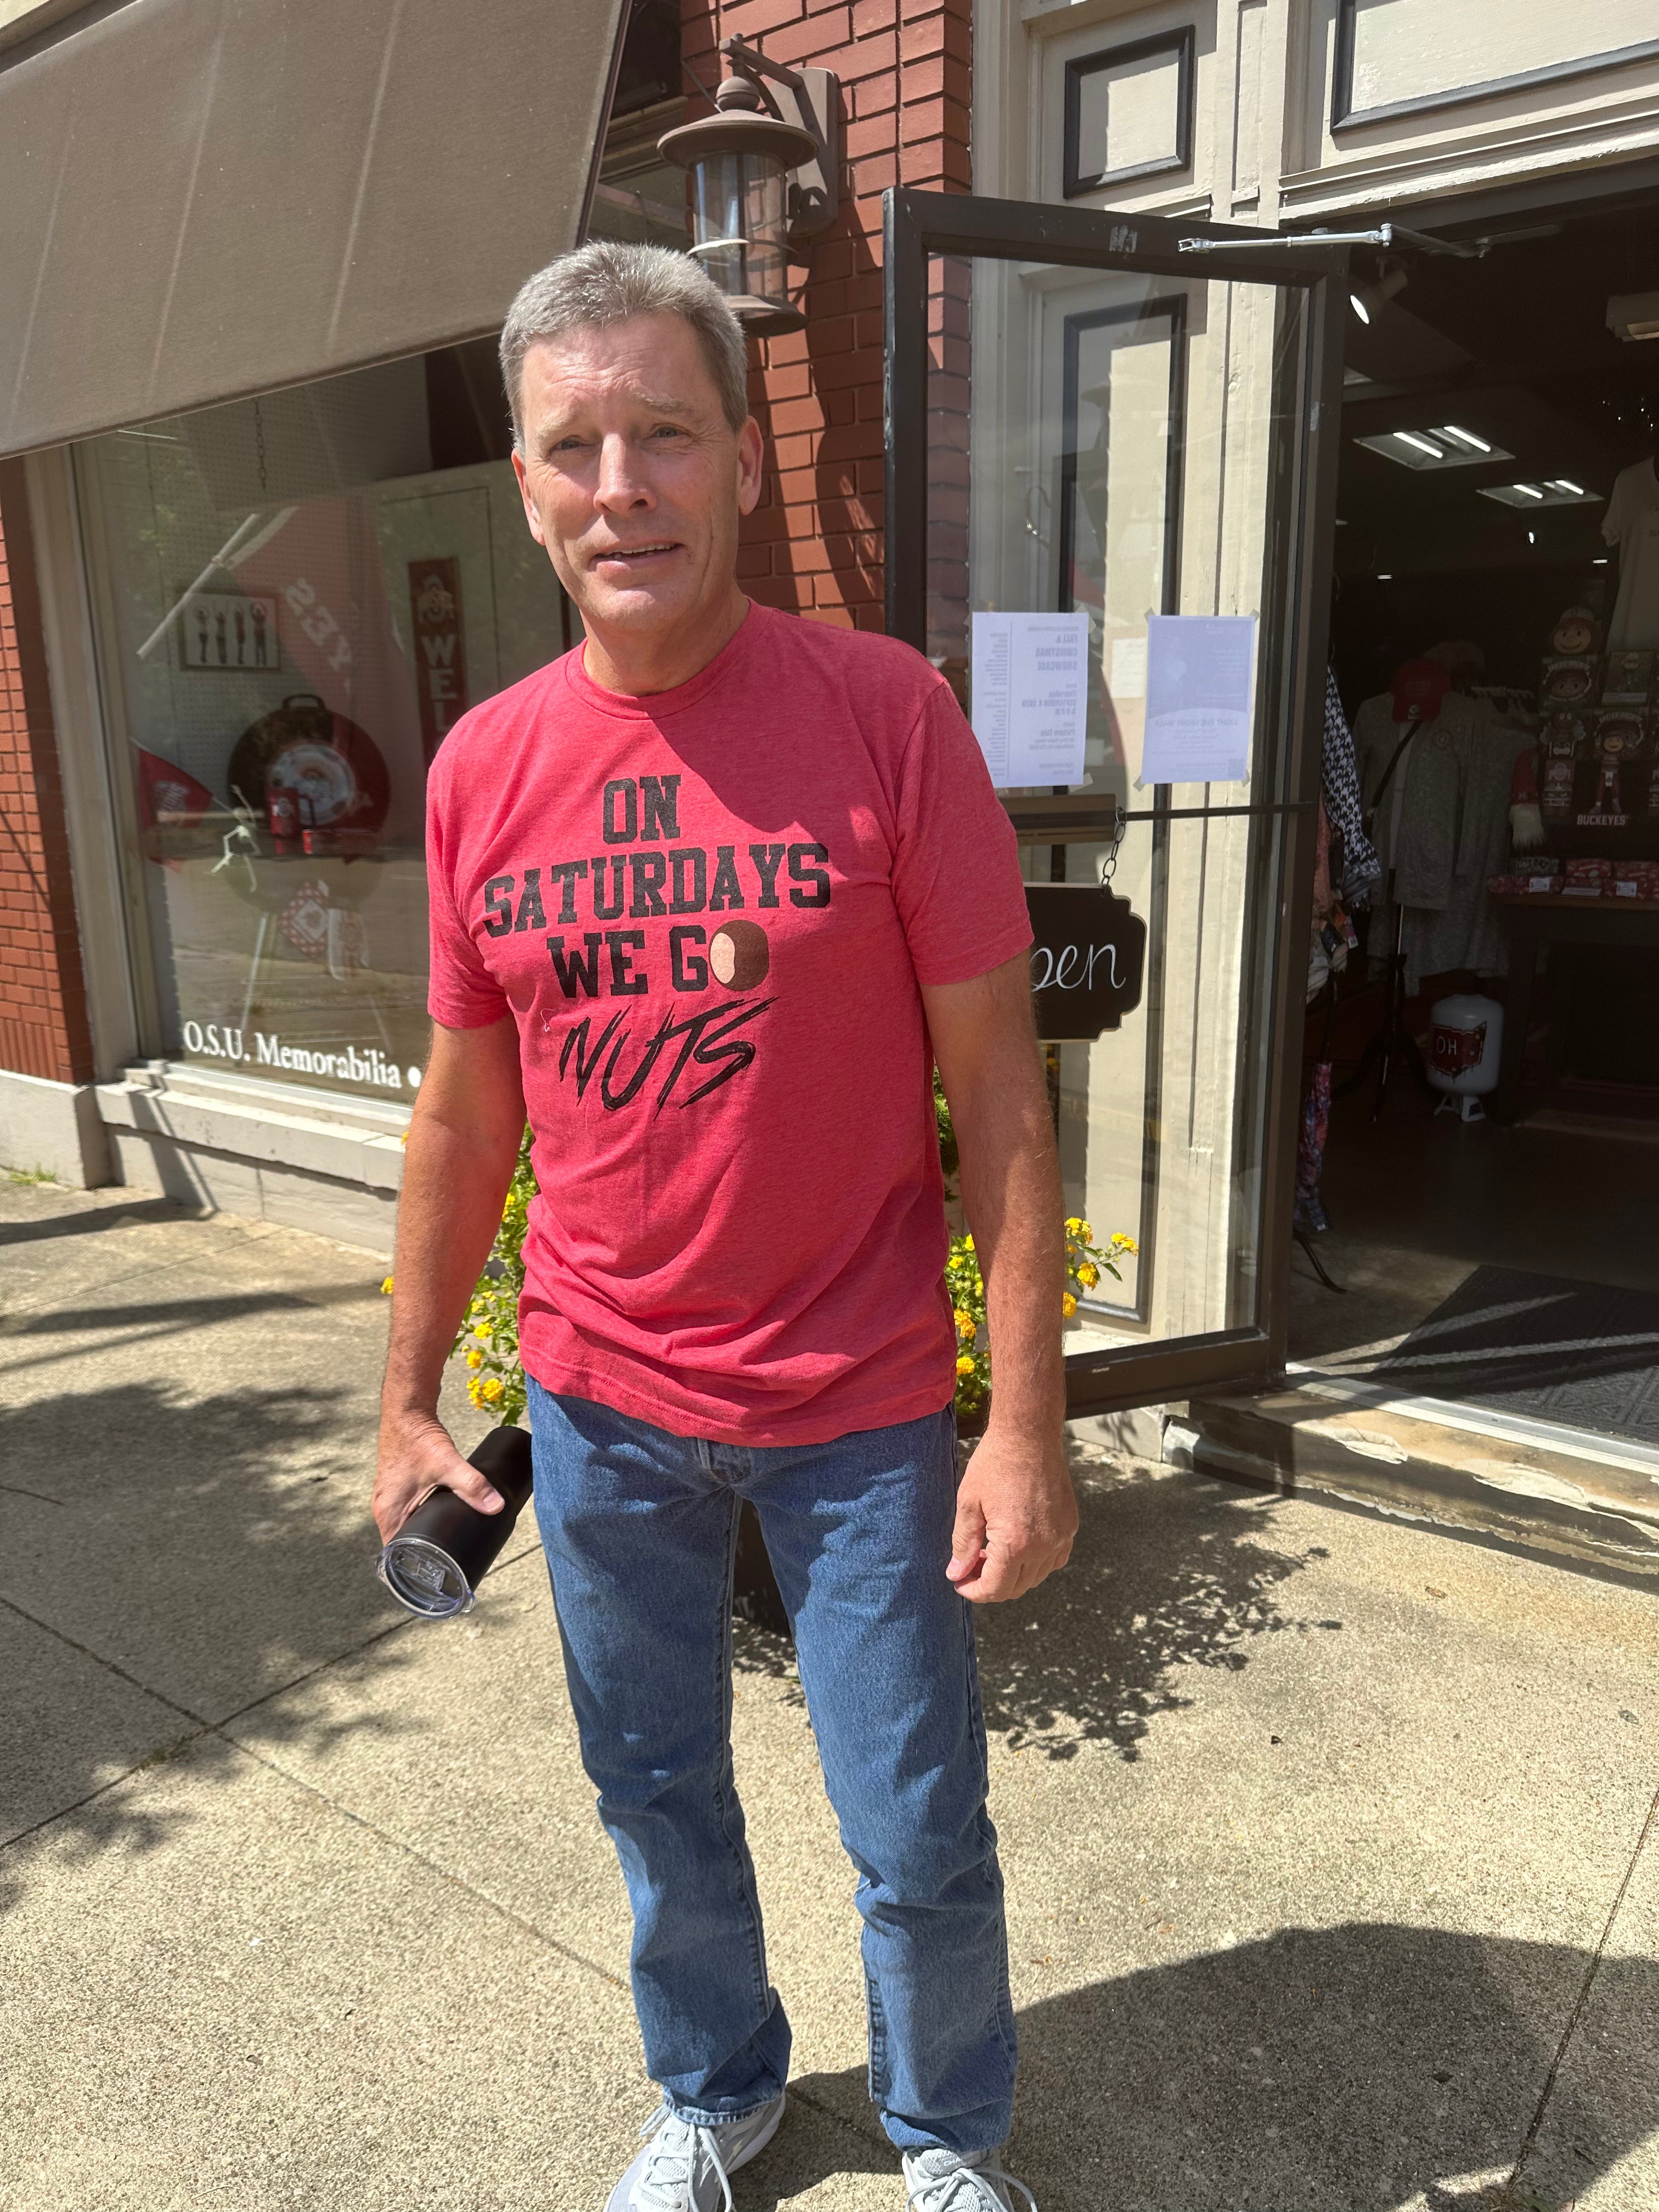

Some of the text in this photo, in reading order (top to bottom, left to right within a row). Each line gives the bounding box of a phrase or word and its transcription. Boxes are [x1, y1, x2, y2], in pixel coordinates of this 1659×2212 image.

[603, 774, 681, 845] ON
[483, 842, 831, 938] SATURDAYS
[546, 929, 648, 998] WE
[183, 1020, 402, 1089] O.S.U. Memorabilia
[558, 996, 781, 1122] NUTS
